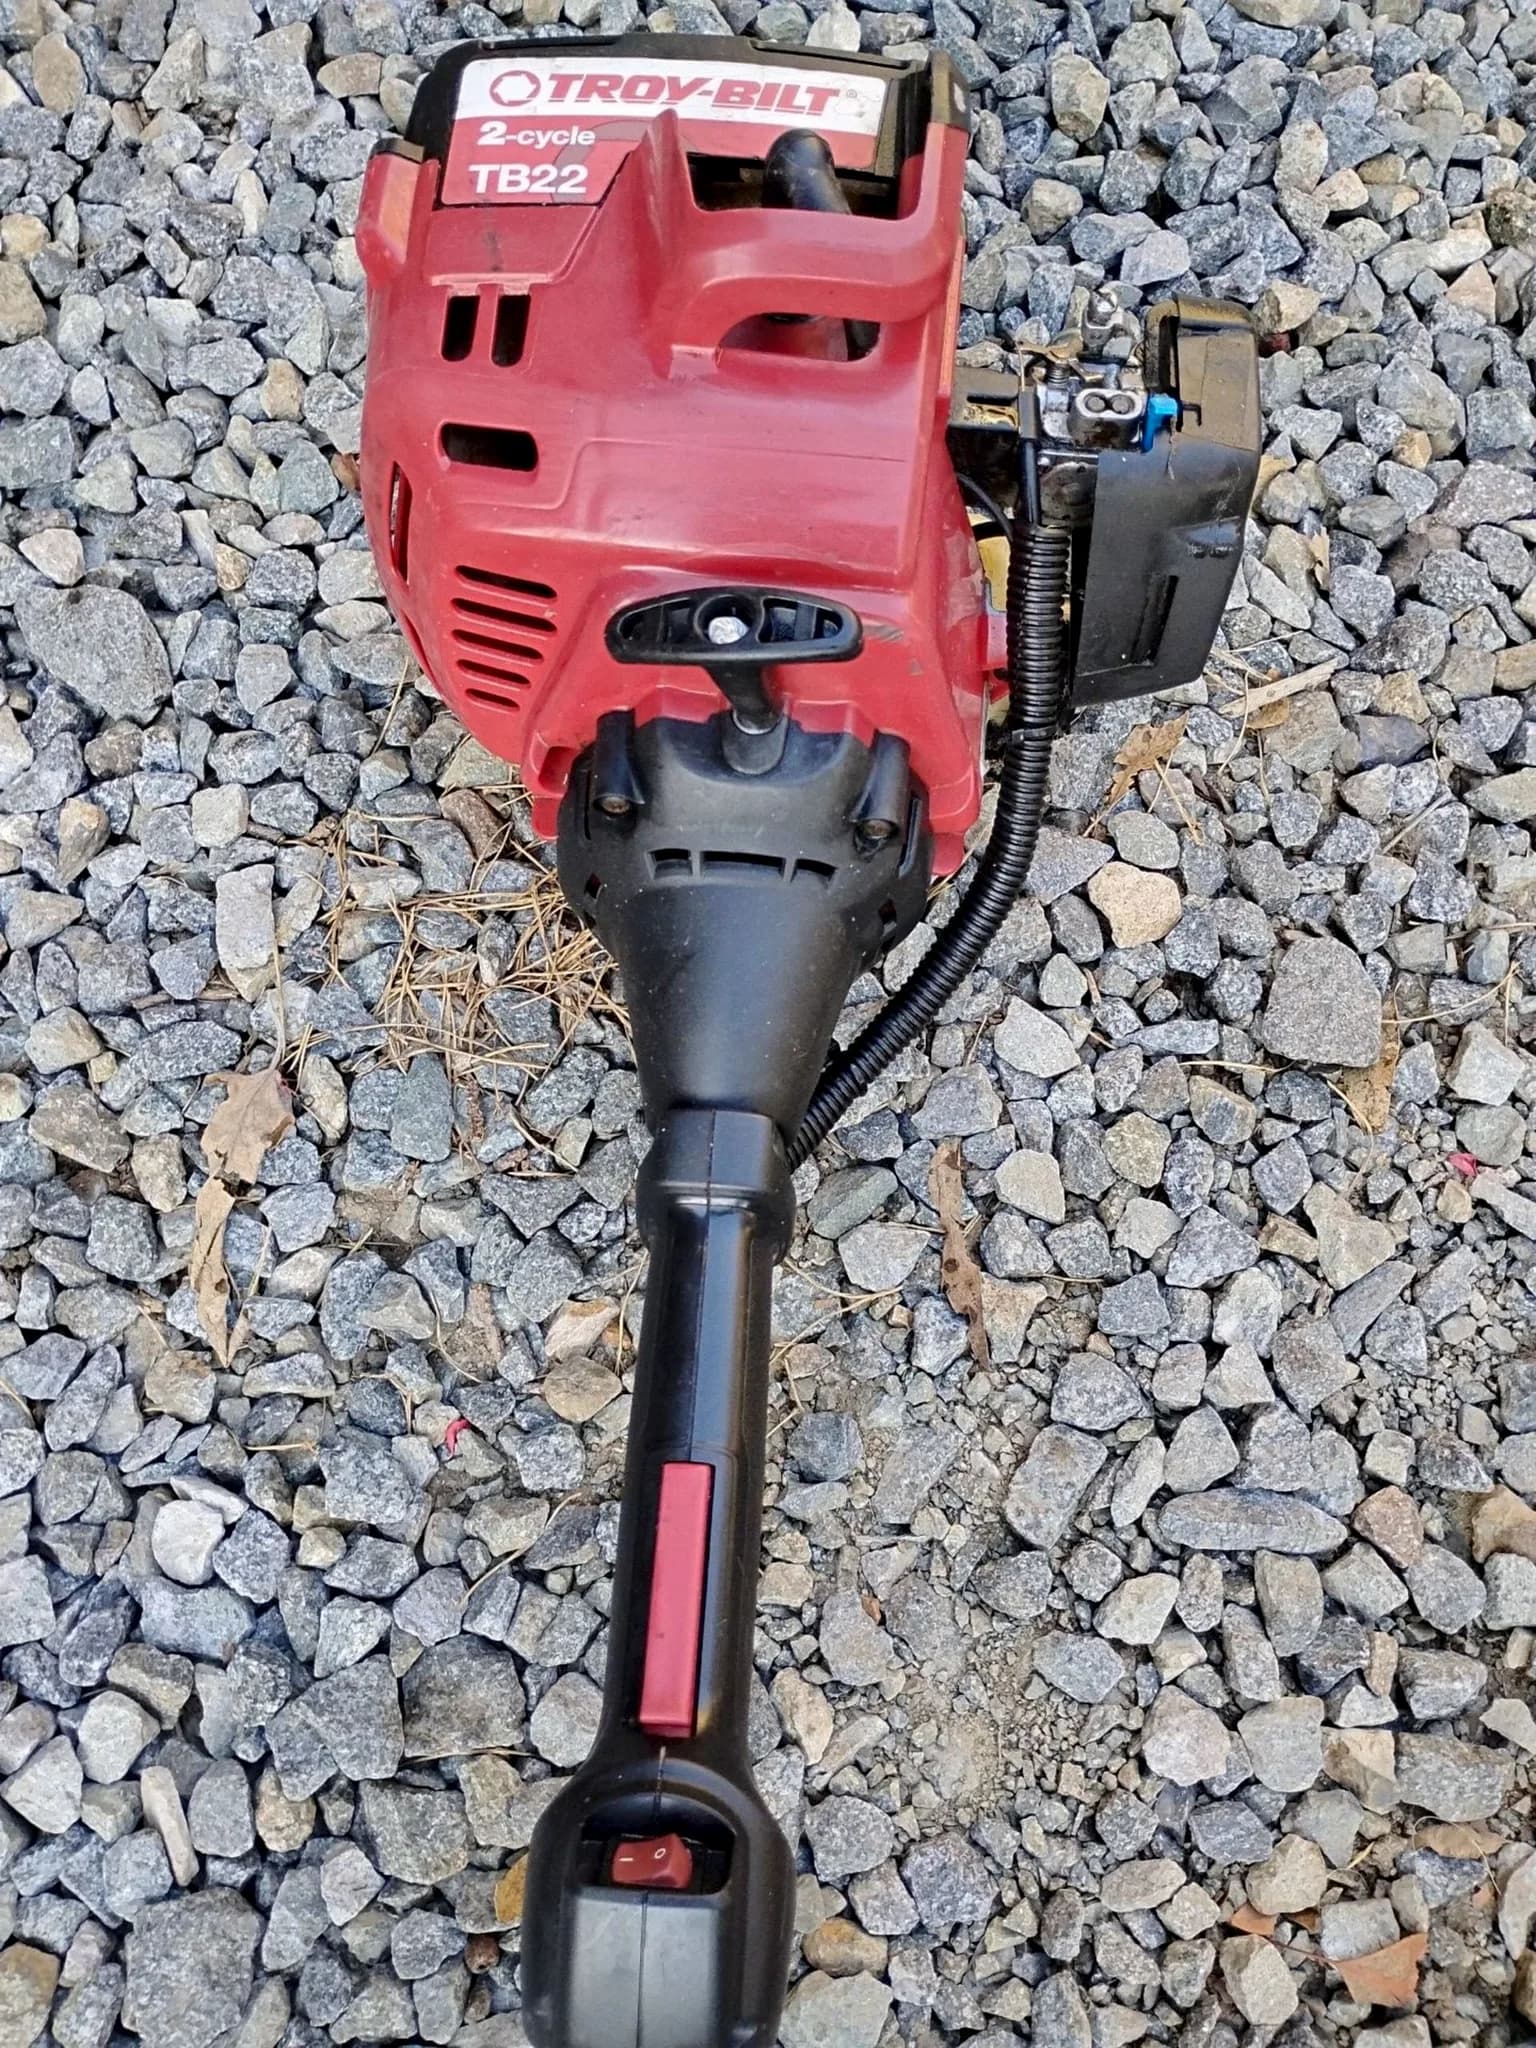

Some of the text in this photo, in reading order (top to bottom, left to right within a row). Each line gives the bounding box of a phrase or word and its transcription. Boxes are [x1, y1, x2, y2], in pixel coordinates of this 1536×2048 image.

[547, 73, 840, 116] TROY-BILT
[477, 121, 596, 149] 2-cycle
[468, 164, 588, 194] TB22
